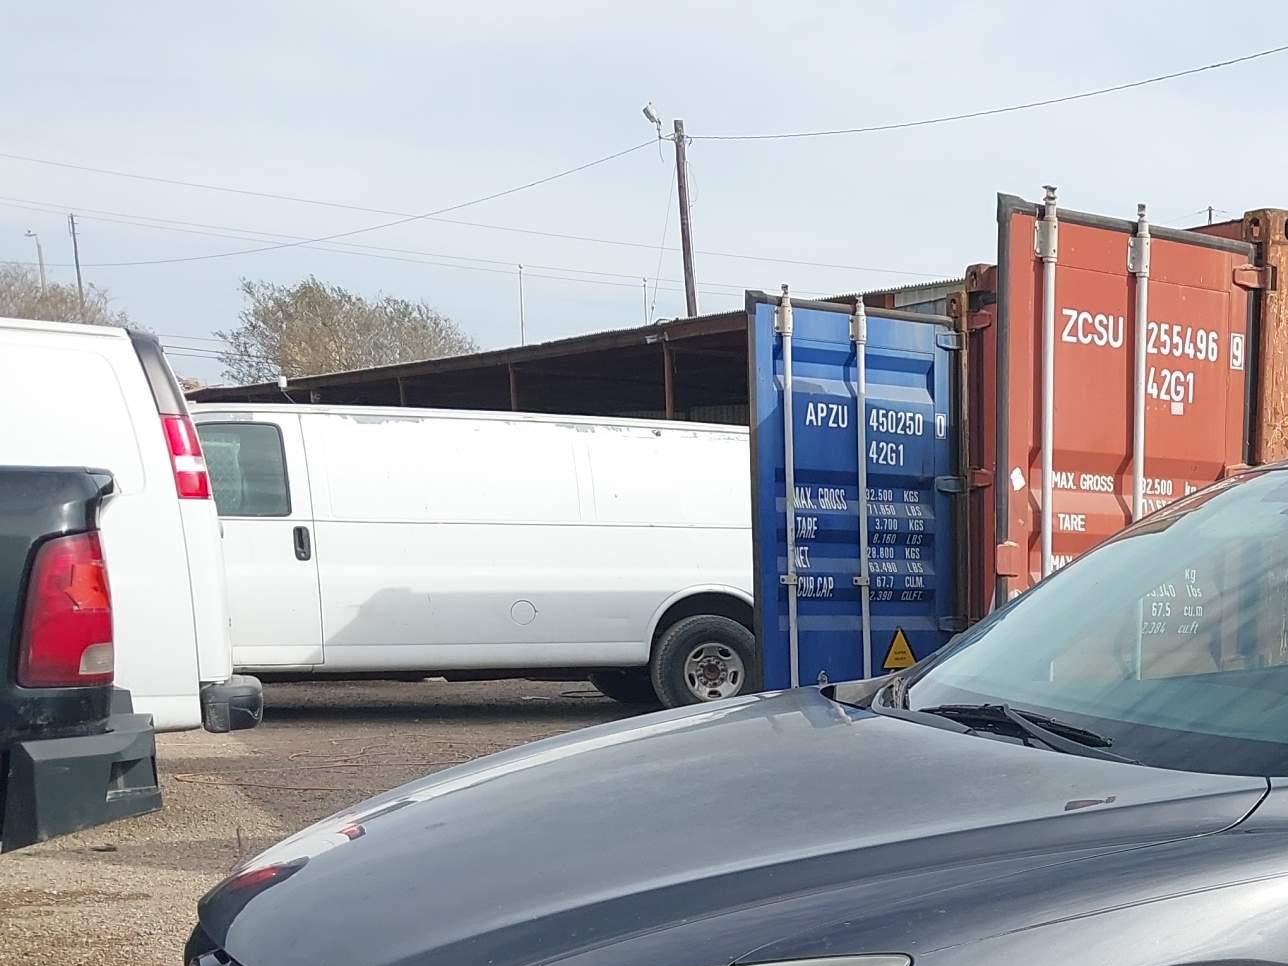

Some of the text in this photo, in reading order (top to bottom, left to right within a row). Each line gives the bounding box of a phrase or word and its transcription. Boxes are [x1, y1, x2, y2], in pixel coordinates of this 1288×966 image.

[1061, 308, 1244, 368] ZCSU 255496 9
[1147, 367, 1195, 404] 42G1
[805, 402, 945, 437] APZU 450250 0
[869, 441, 904, 466] 42G1
[1051, 471, 1076, 490] MAX.
[1080, 474, 1114, 492] GROSS
[793, 487, 817, 509] MAX.
[818, 488, 848, 511] GROSS
[904, 490, 919, 502] KGS
[905, 505, 922, 516] LBS
[796, 517, 924, 538] TARE 3.700 KGS
[1058, 513, 1086, 532] TARE
[906, 534, 923, 545] LBS
[795, 546, 811, 568] NET
[905, 547, 920, 559] KGS
[907, 562, 924, 573] LBS
[876, 576, 894, 588] 67.7
[1185, 583, 1202, 598] lbs
[1151, 602, 1171, 617] 67.5
